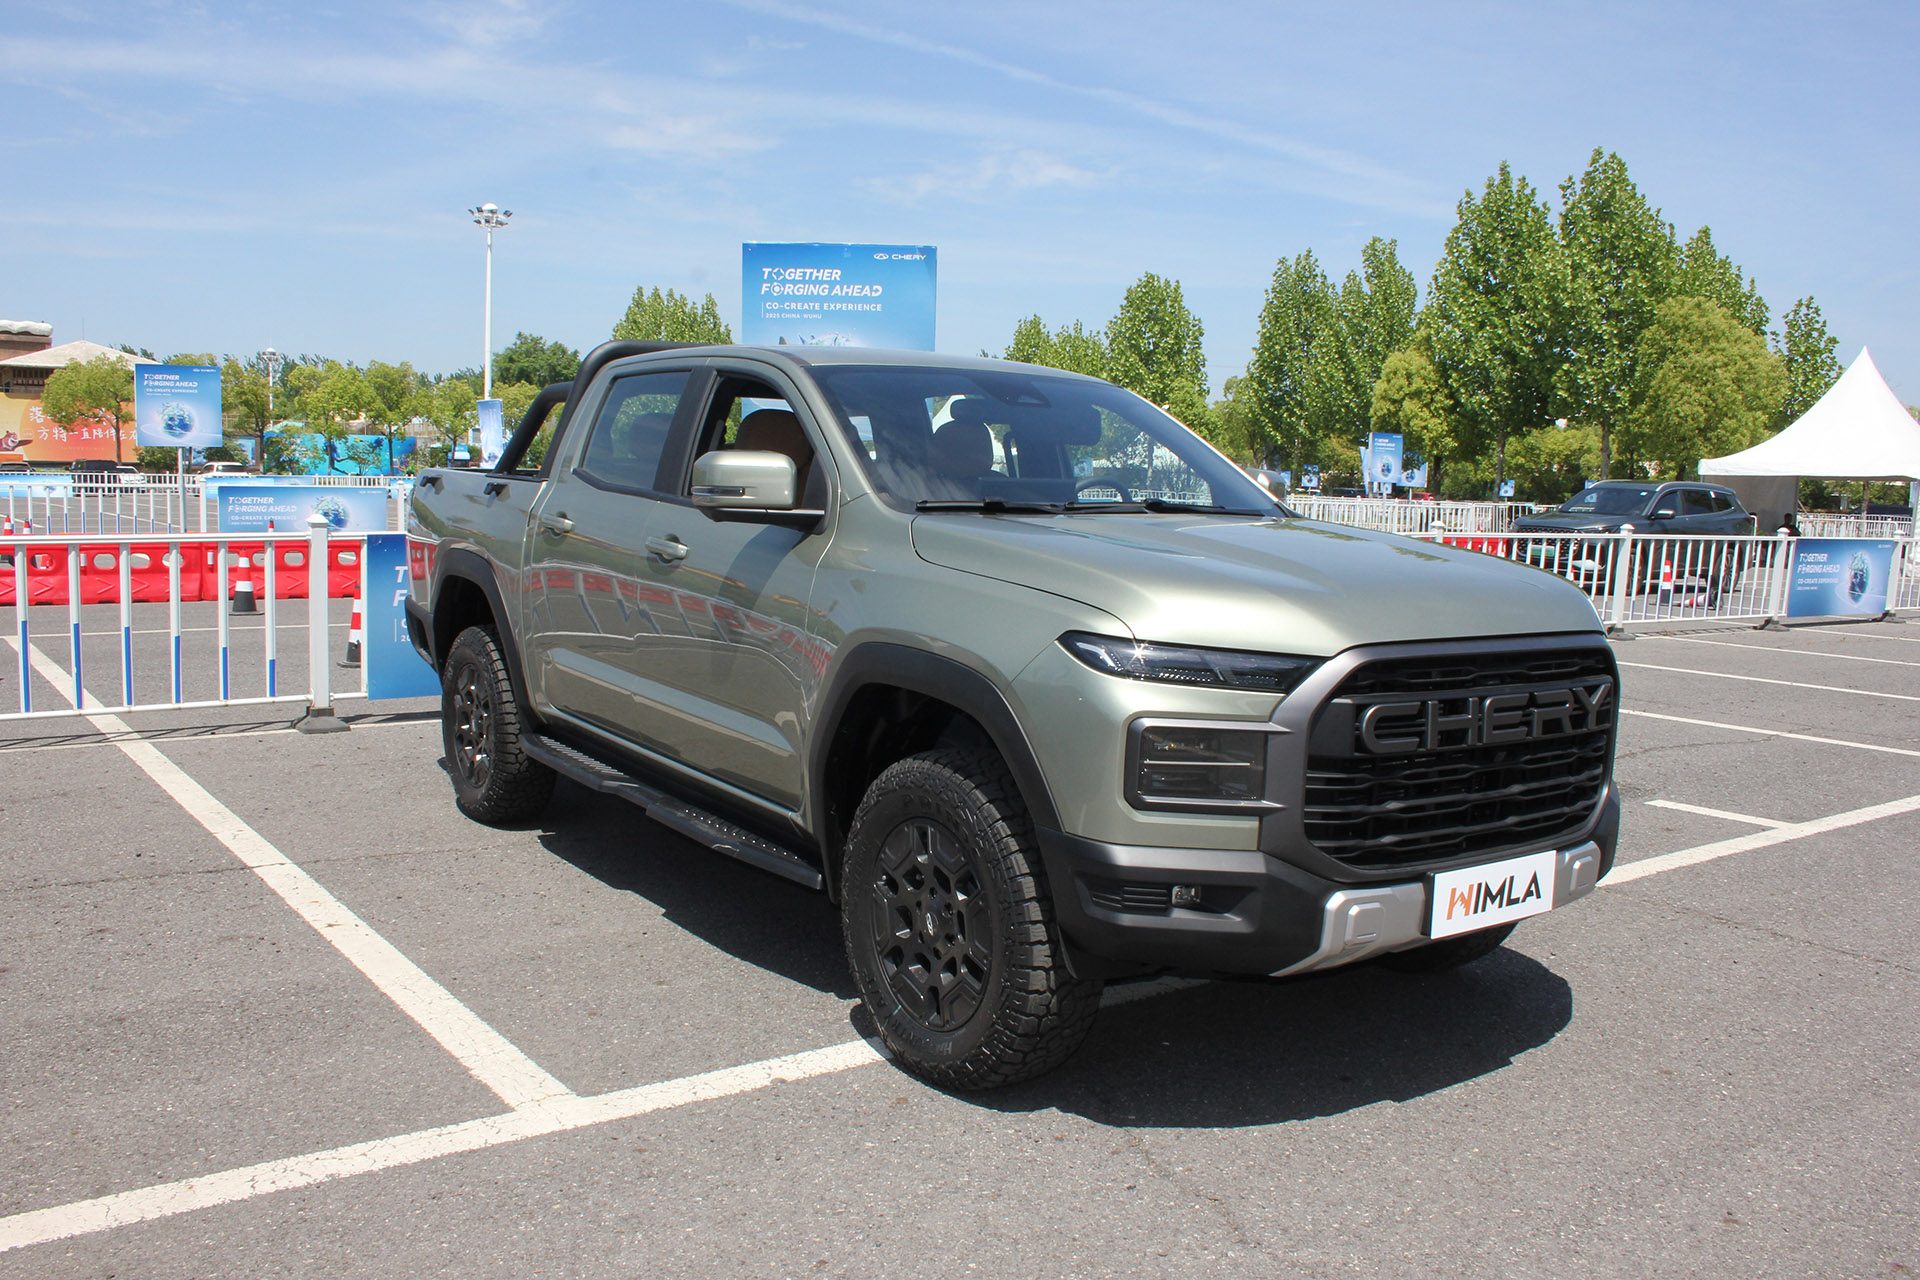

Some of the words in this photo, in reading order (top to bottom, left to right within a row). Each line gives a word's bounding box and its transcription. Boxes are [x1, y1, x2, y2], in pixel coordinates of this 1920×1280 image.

[762, 267, 842, 281] TOGETHER
[761, 282, 829, 296] FORGING
[831, 284, 883, 297] AHEAD
[765, 302, 820, 310] CO-CREATE
[823, 303, 883, 312] EXPERIENCE
[228, 496, 274, 504] TOGETHER
[227, 504, 268, 513] FORGING
[1362, 683, 1611, 754] CHERY
[1446, 870, 1541, 921] WIMLA
